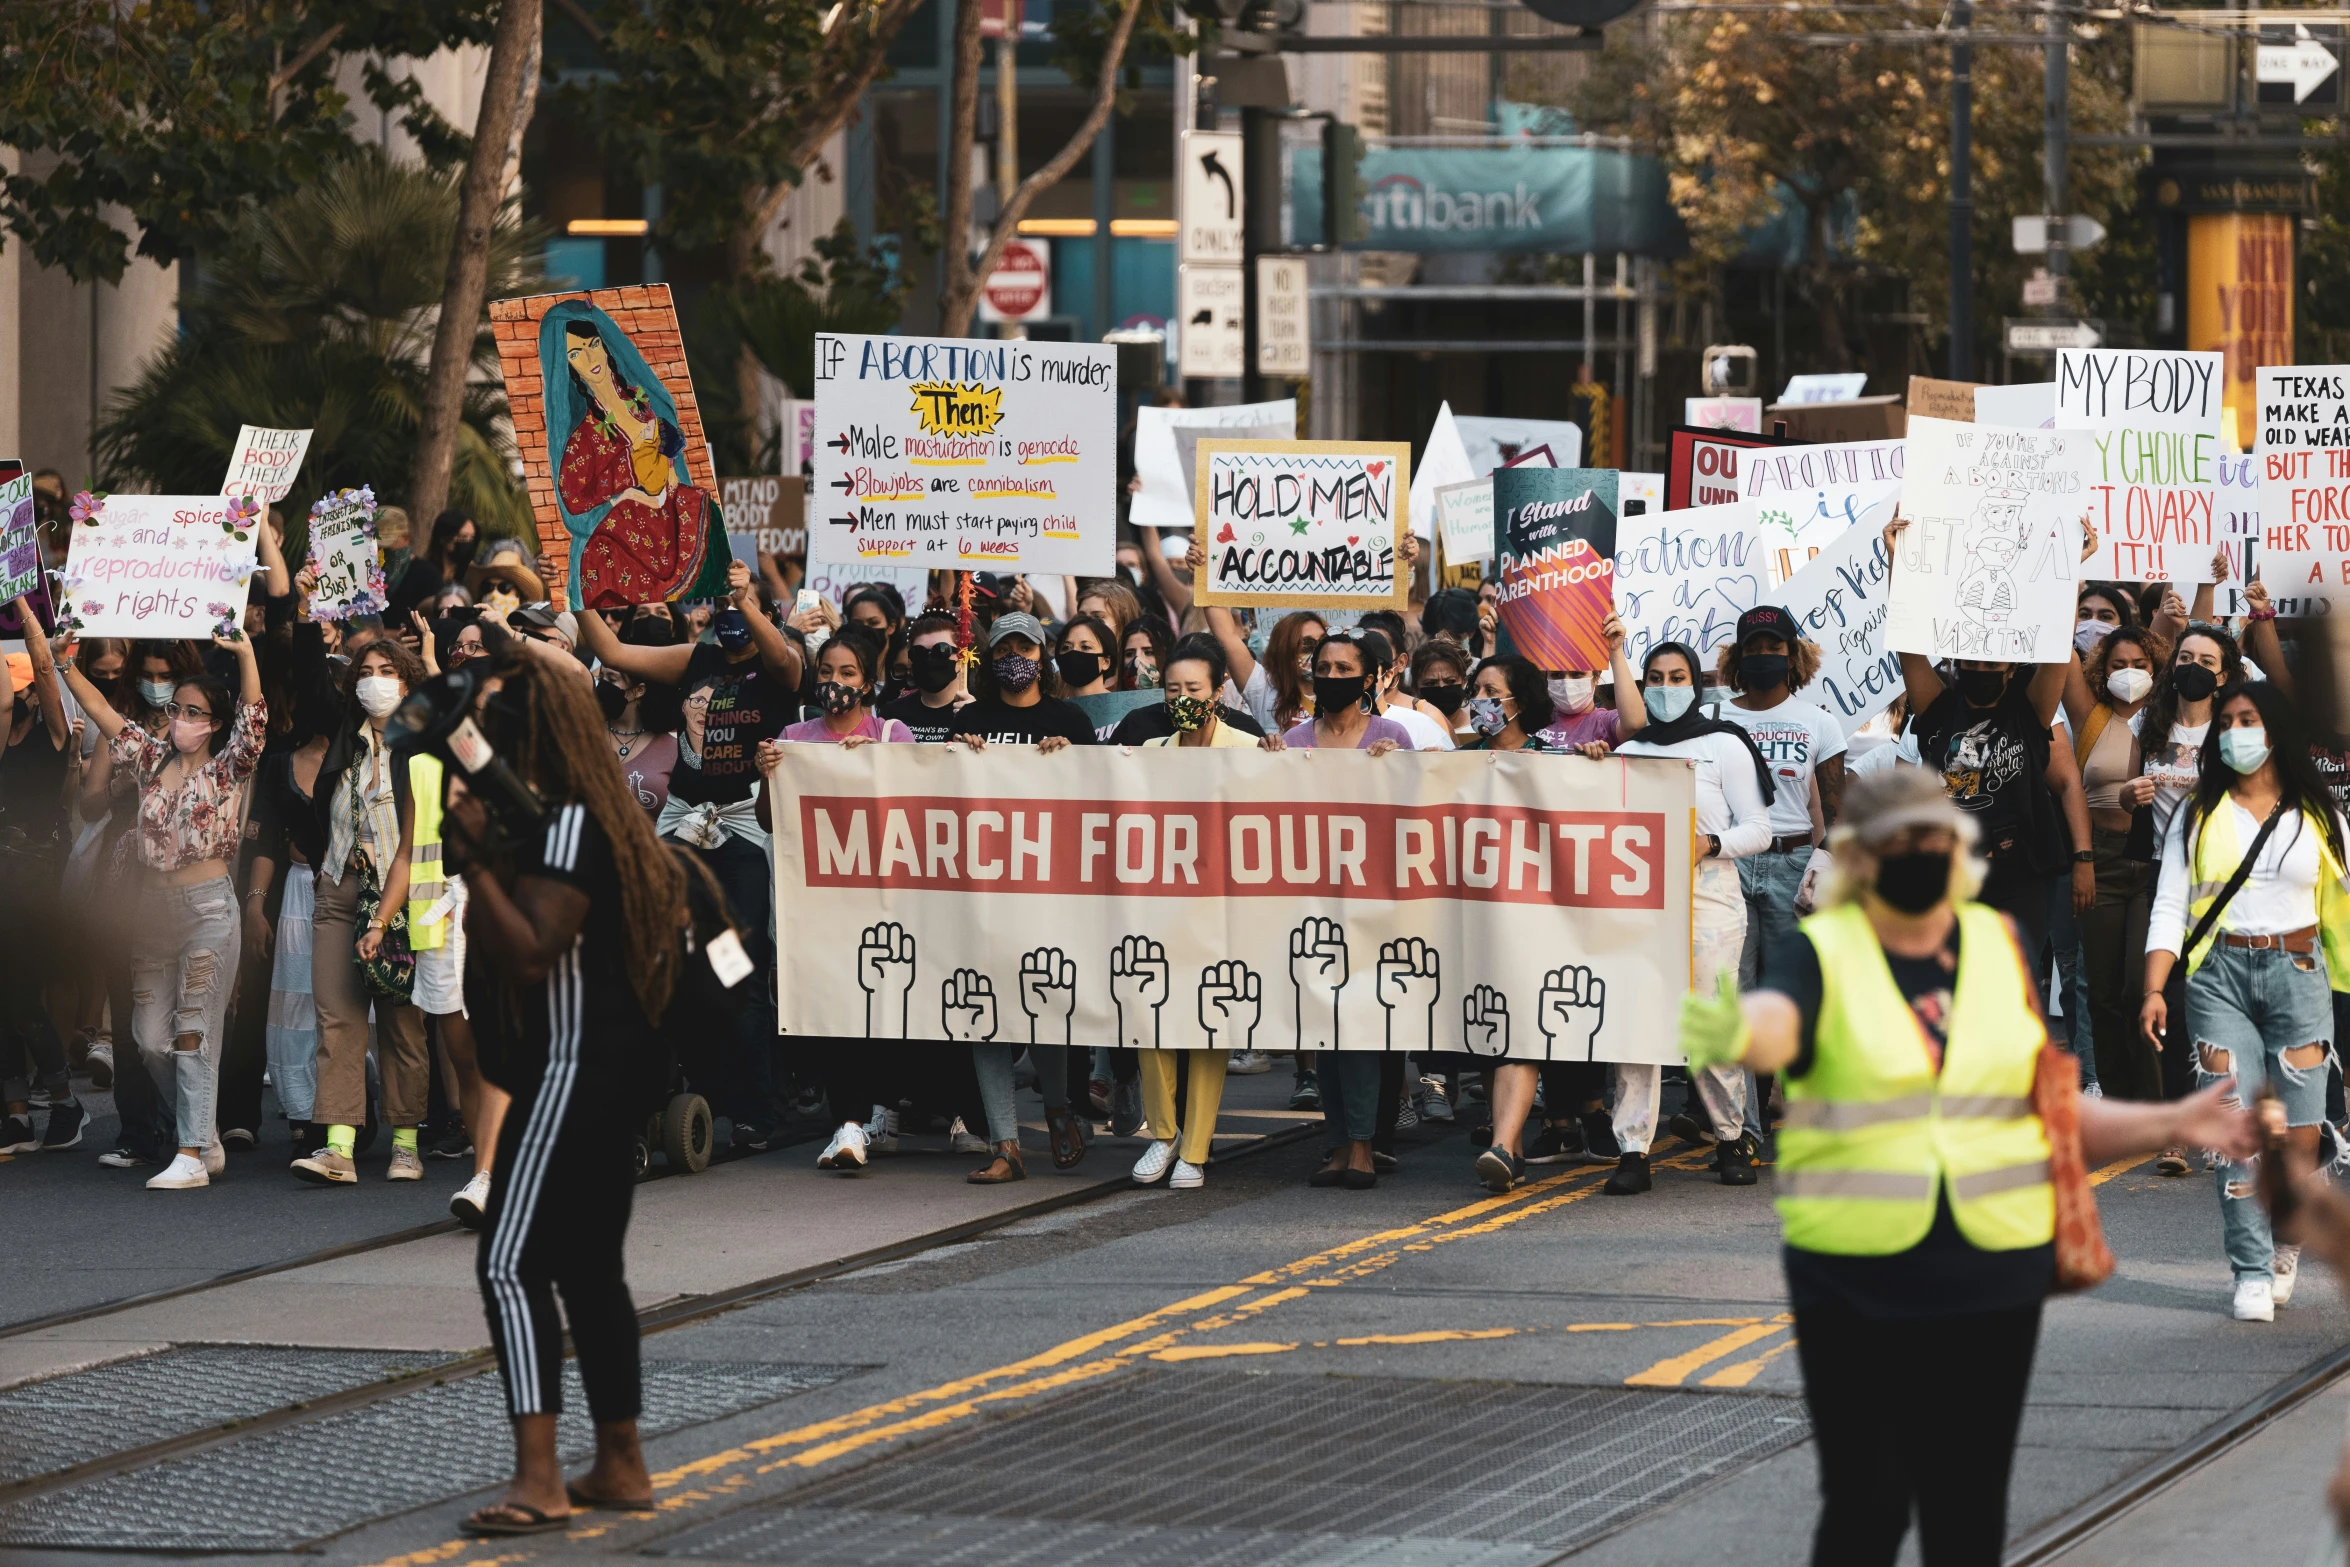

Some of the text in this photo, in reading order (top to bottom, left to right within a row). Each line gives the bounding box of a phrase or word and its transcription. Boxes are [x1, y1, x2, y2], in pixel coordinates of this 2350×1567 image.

[1361, 182, 1543, 231] itibank
[816, 338, 1111, 392] If ABORTION is murder,
[2061, 353, 2118, 417] MY
[2125, 356, 2214, 417] BODY
[2272, 376, 2345, 400] TEXAS
[919, 389, 990, 425] Then:
[2266, 403, 2350, 425] MAKE A
[247, 428, 300, 450] THEIR
[849, 424, 1081, 465] Male masturbation is genocide
[1956, 433, 1974, 448] IF
[2046, 437, 2066, 456] SO
[2265, 428, 2297, 446] OLD
[243, 448, 299, 467] BODY
[1979, 452, 2050, 470] AGAINST
[2120, 428, 2215, 486] CHOICE
[2266, 451, 2314, 481] BUT
[239, 464, 290, 484] THEIR
[855, 466, 1055, 500] Blowjobs are cannibalism
[1943, 466, 2081, 494] ABORTIONS
[8, 474, 31, 504] OUR
[224, 480, 294, 503] CHOICE
[724, 478, 779, 502] MIND
[1213, 469, 1390, 523] HOLD MEN
[172, 503, 223, 529] spice
[724, 502, 771, 528] BODY
[860, 506, 1077, 537] Men must start paying child
[1475, 506, 1491, 515] are
[1506, 489, 1592, 535] I Stand
[2125, 486, 2214, 545] OVARY
[132, 527, 170, 546] and
[1528, 523, 1558, 541] with
[2267, 523, 2350, 553] HER TO
[330, 550, 347, 568] OR
[857, 536, 1019, 556] support at 6 weeks
[1500, 538, 1588, 579] PLANNED
[1899, 514, 1965, 575] GET
[2029, 516, 2071, 583] A
[81, 555, 234, 584] reproductive
[1218, 545, 1394, 584] ACCOUNTABLE
[2307, 561, 2324, 584] A
[1494, 558, 1614, 608] PARENTHOOD
[1673, 579, 1711, 610] a
[115, 588, 198, 620] rights
[1746, 611, 1779, 625] PUSSY
[710, 697, 735, 710] THE
[706, 709, 761, 727] THINGS
[908, 725, 936, 734] OMAN'S
[1755, 721, 1801, 733] STRIPES
[705, 728, 735, 743] YOU
[703, 744, 743, 760] CARE
[702, 759, 754, 777] ABOUT
[813, 808, 1652, 897] MARCH FOR OUR RIGHTS
